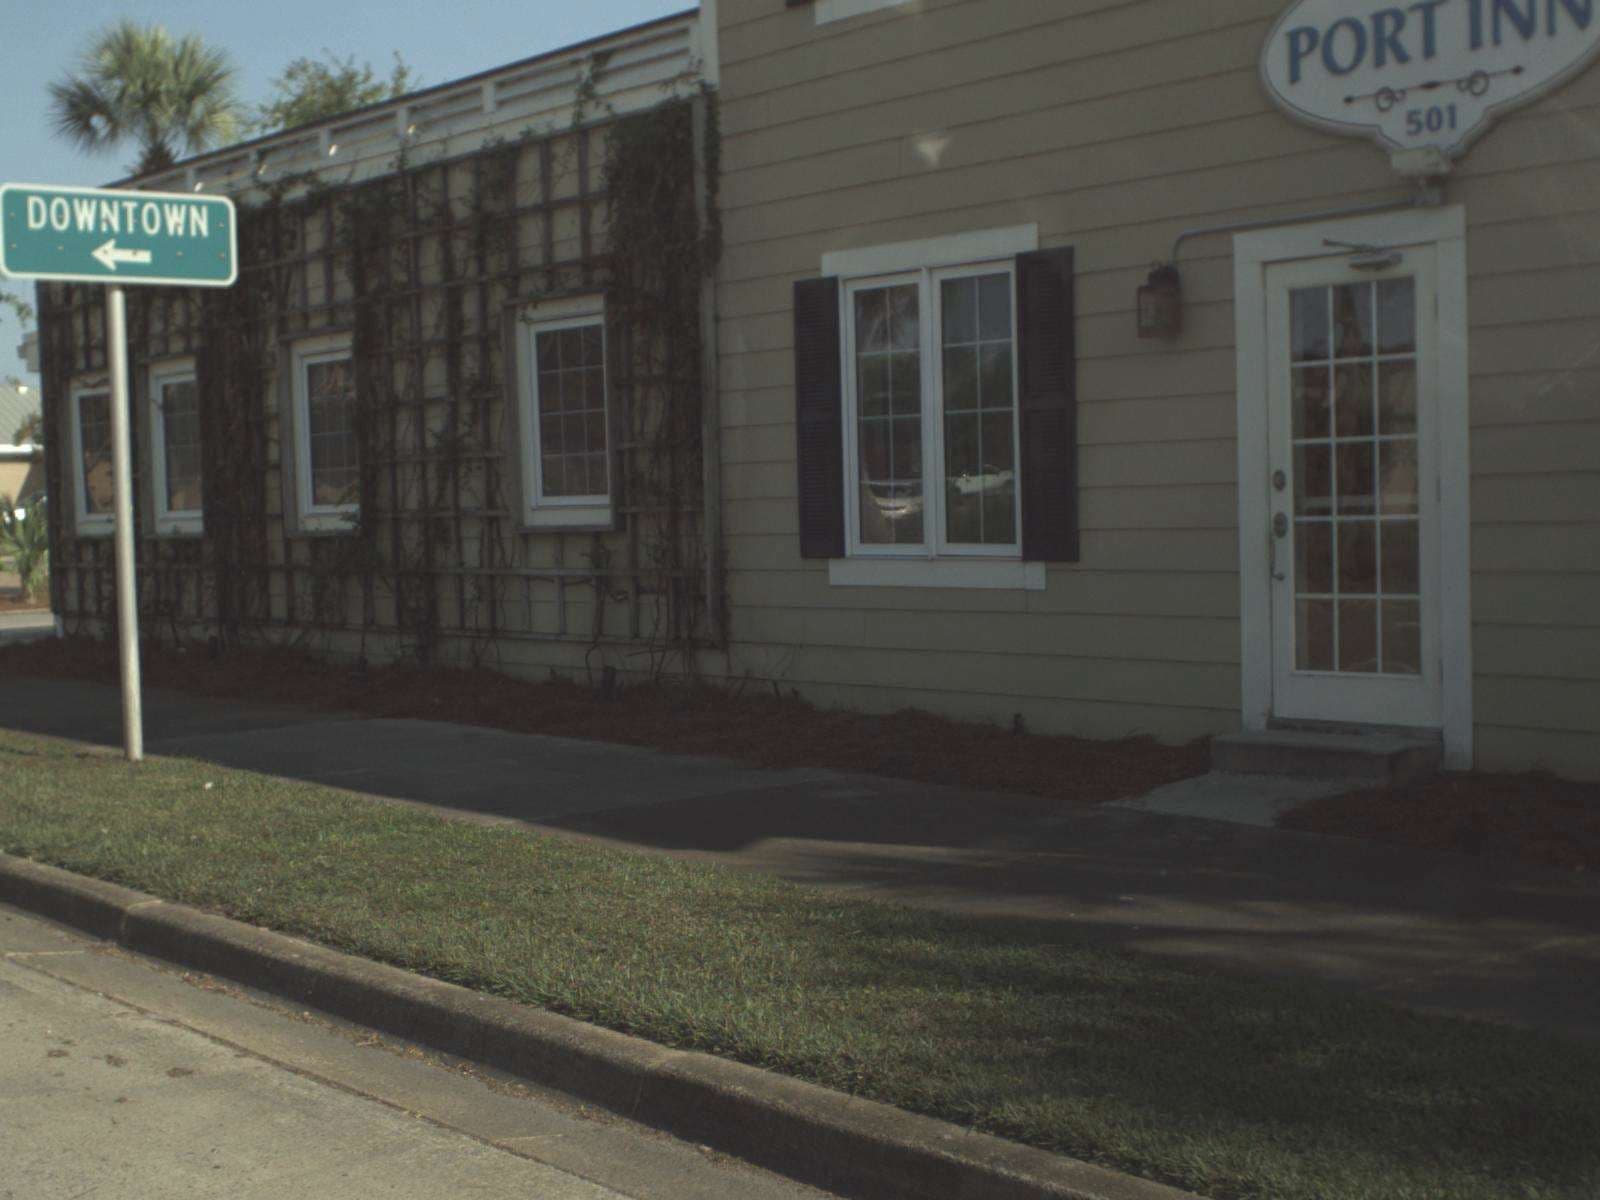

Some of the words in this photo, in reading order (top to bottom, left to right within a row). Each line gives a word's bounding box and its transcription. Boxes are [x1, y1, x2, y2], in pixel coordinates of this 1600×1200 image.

[1285, 0, 1446, 85] PORT
[1406, 103, 1457, 136] 501
[27, 195, 209, 237] DOWNTOWN
